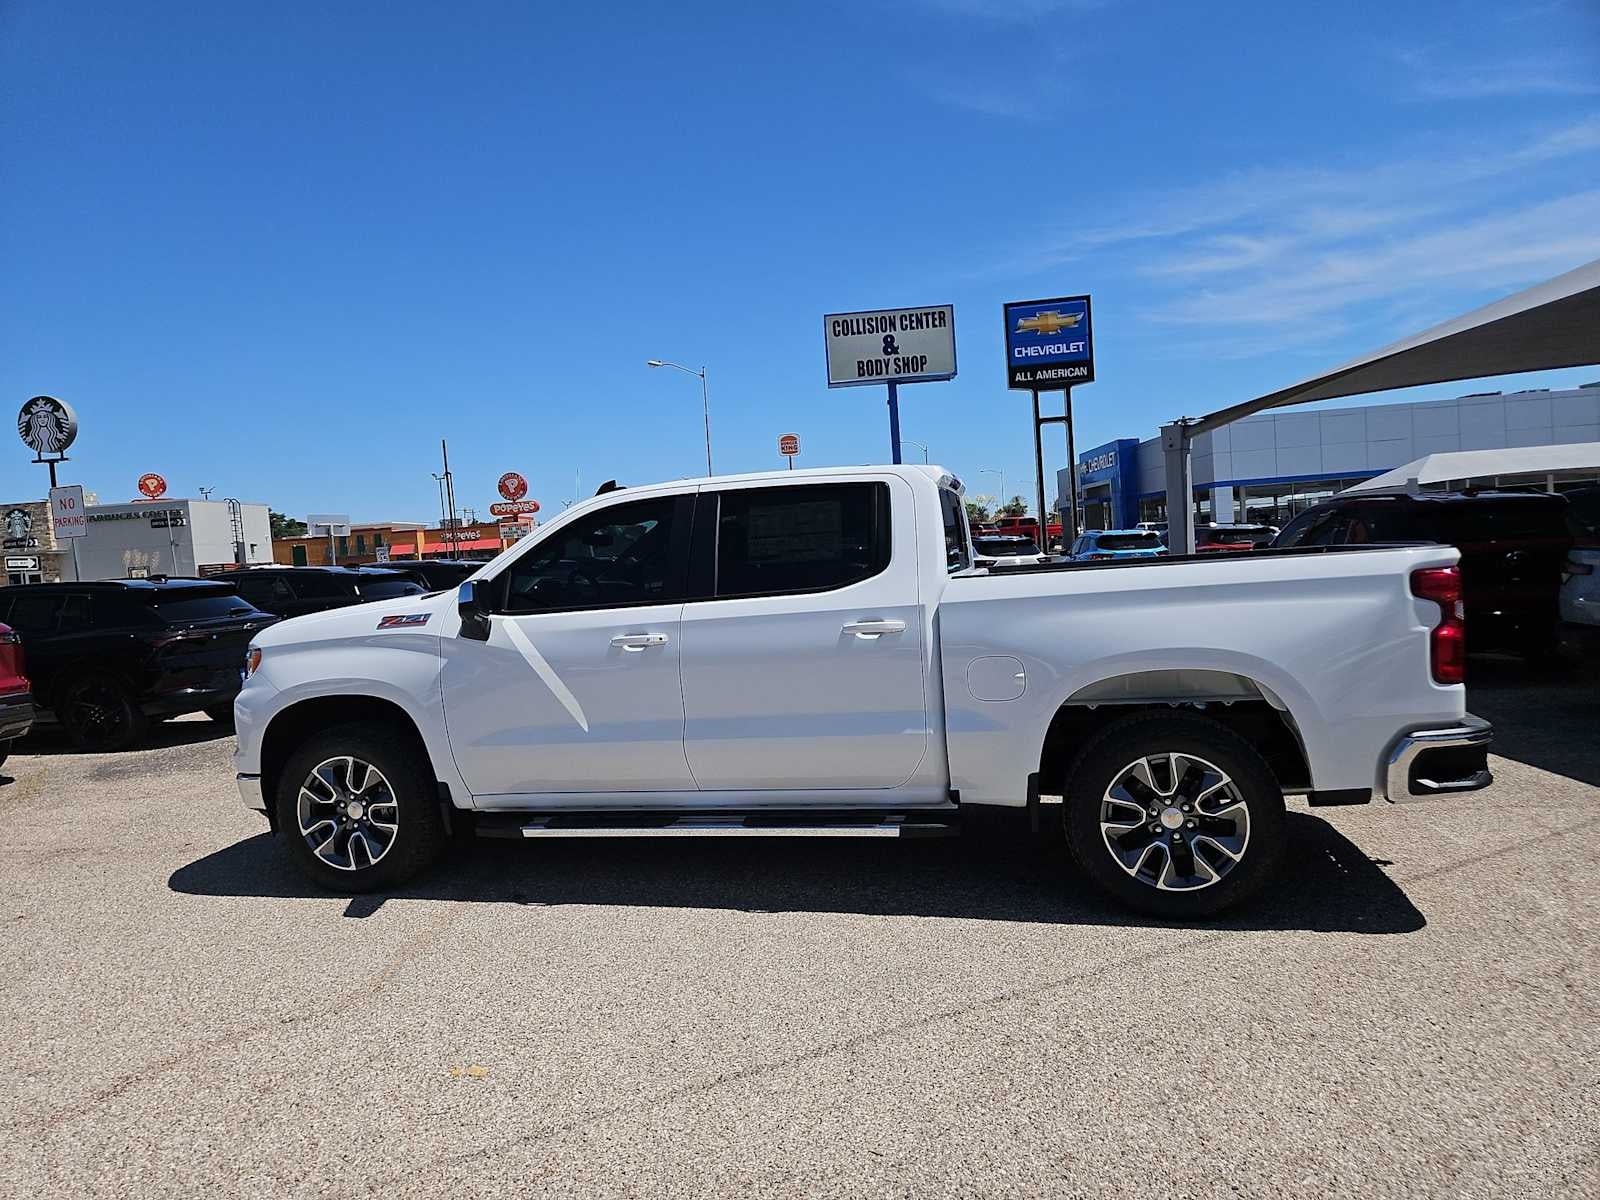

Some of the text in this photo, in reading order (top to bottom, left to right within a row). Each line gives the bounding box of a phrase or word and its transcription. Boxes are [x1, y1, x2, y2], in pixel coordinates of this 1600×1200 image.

[832, 311, 946, 337] COLLISION CENTER
[882, 334, 899, 355] &
[1014, 341, 1085, 358] CHEVROLET
[857, 355, 927, 377] BODY SHOP
[1015, 367, 1088, 381] ALL AMERICAN
[59, 498, 75, 511] NO
[55, 516, 85, 527] PARKING
